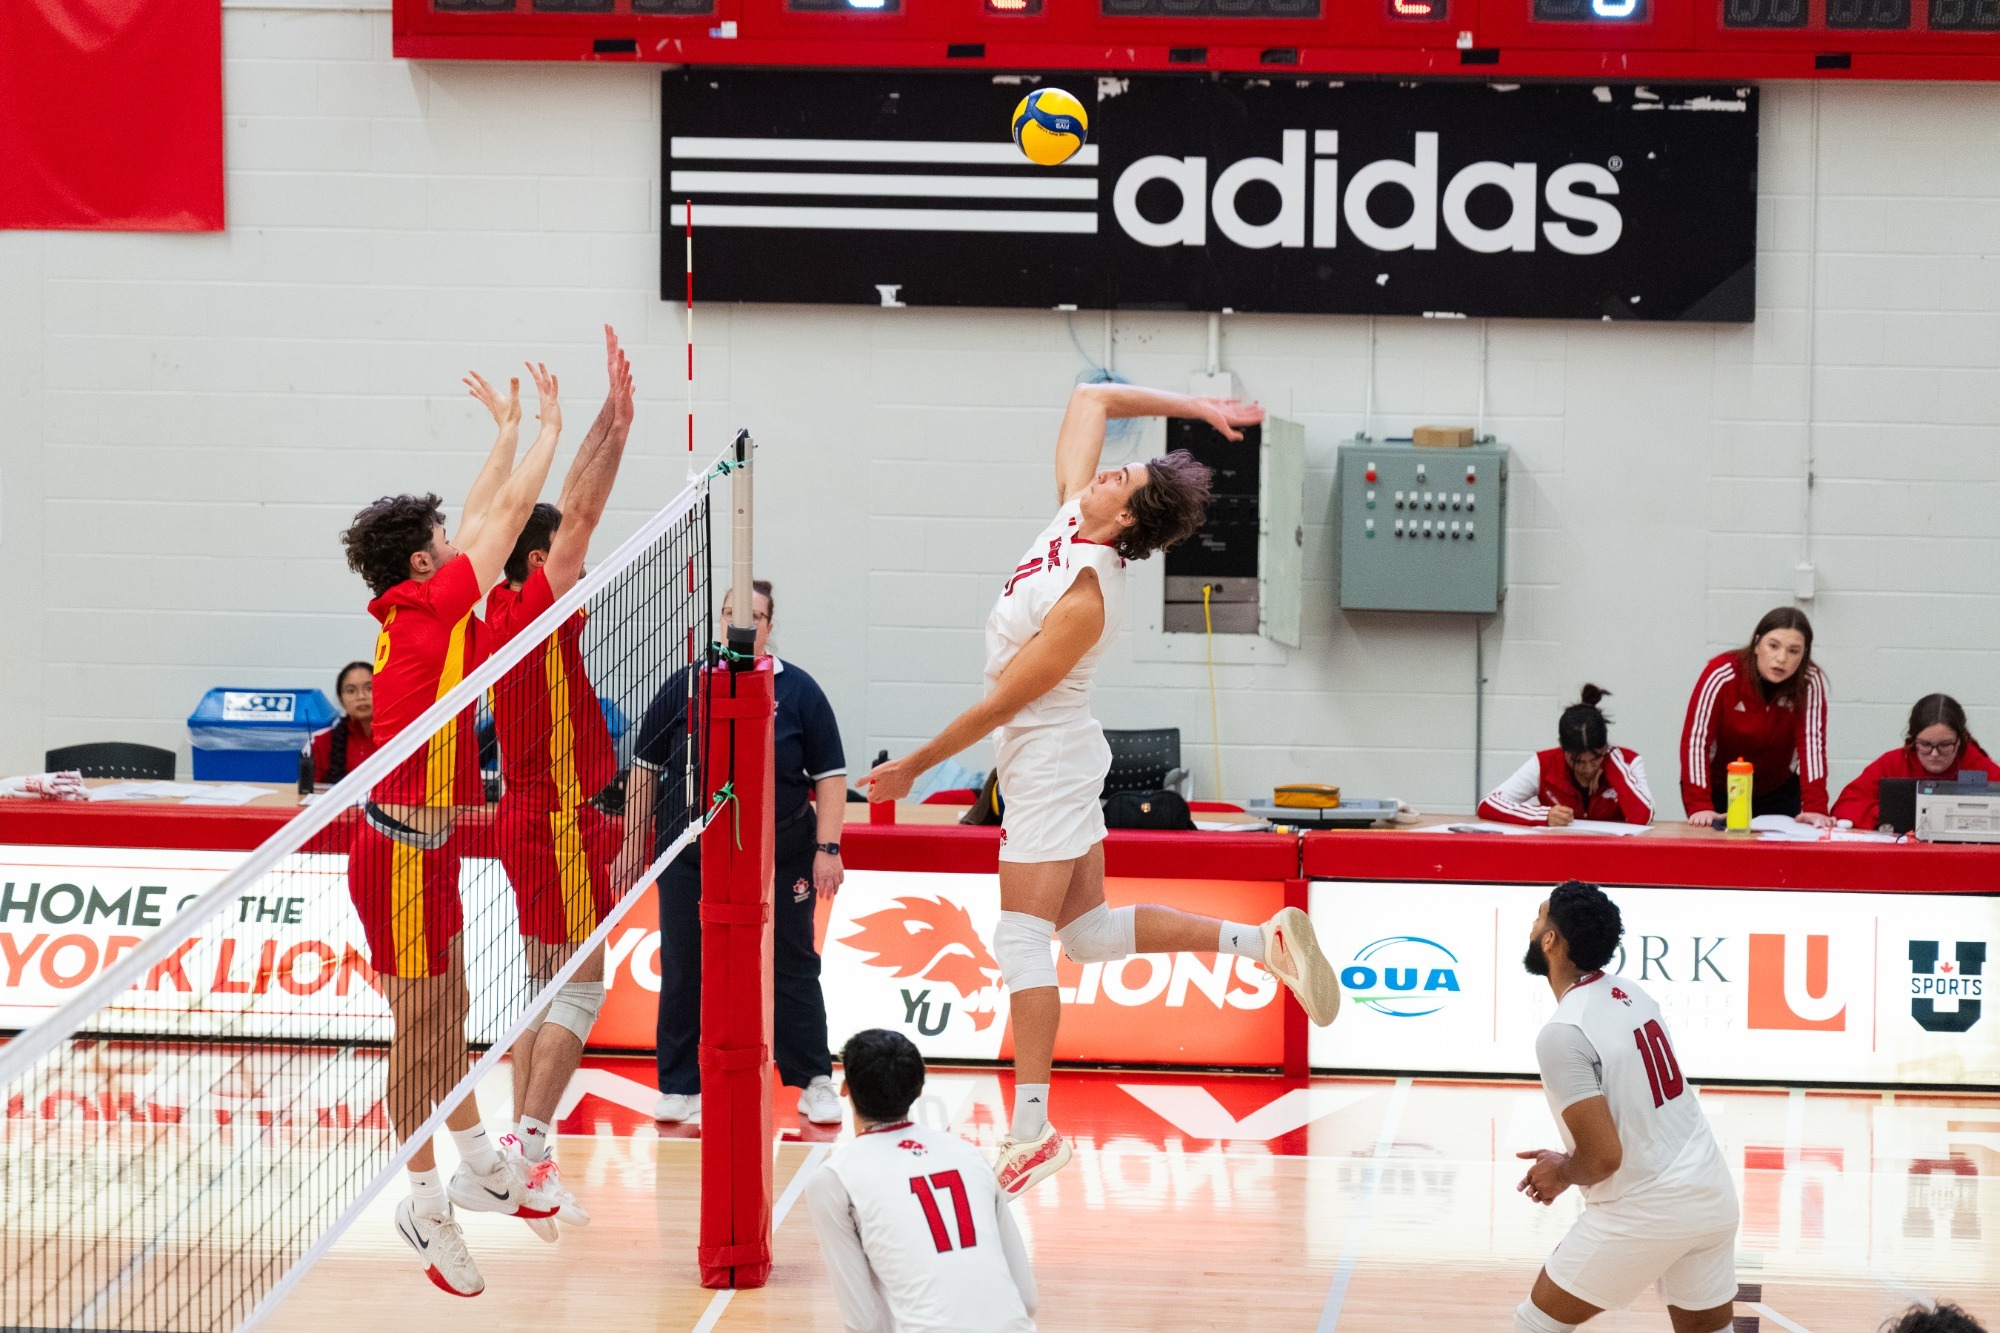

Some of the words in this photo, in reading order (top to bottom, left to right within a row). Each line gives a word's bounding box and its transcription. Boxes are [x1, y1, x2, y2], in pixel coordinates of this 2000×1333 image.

[1113, 128, 1623, 255] adidas
[0, 882, 167, 927] HOME
[237, 896, 305, 924] THE
[1341, 966, 1461, 991] OUA
[1911, 977, 1983, 996] SPORTS
[900, 989, 951, 1036] YU
[1633, 1018, 1684, 1109] 10
[909, 1169, 977, 1254] 17
